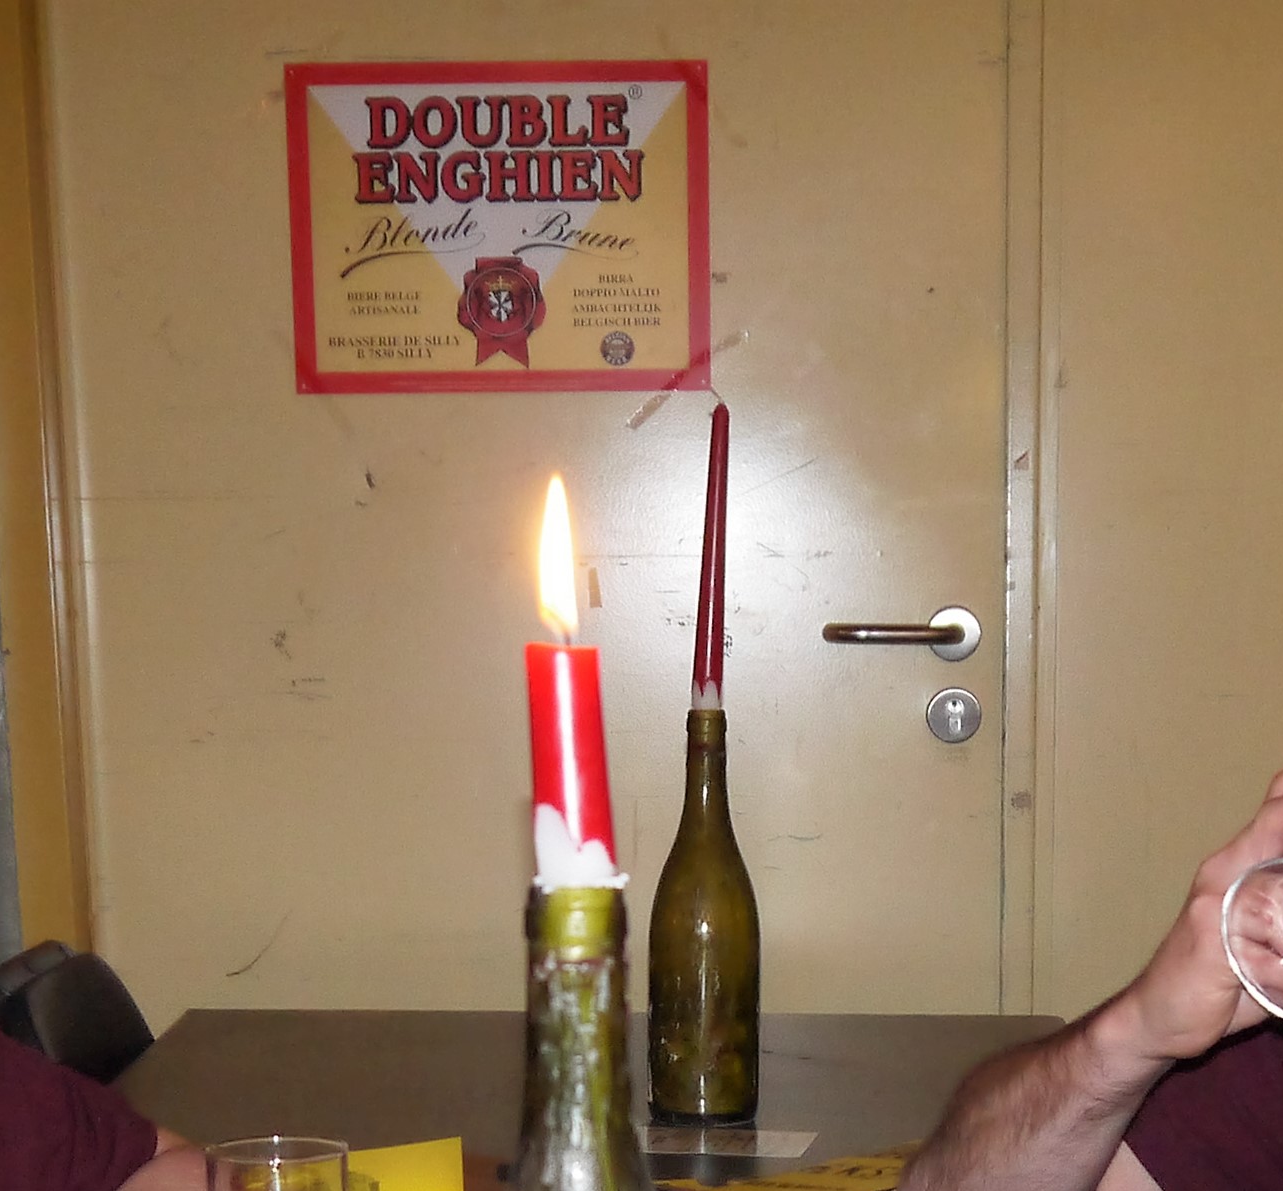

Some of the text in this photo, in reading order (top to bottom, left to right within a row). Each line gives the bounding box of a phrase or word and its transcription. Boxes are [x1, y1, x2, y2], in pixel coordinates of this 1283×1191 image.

[364, 93, 630, 150] DOUBLE
[352, 149, 646, 205] ENGHIEN
[345, 208, 638, 256] Blonde Brune
[573, 288, 660, 297] DOPPIO MALTO
[350, 304, 420, 316] ARTISANALE
[328, 334, 461, 347] BRASSERIE DE SILLY
[398, 348, 433, 359] SILLY
